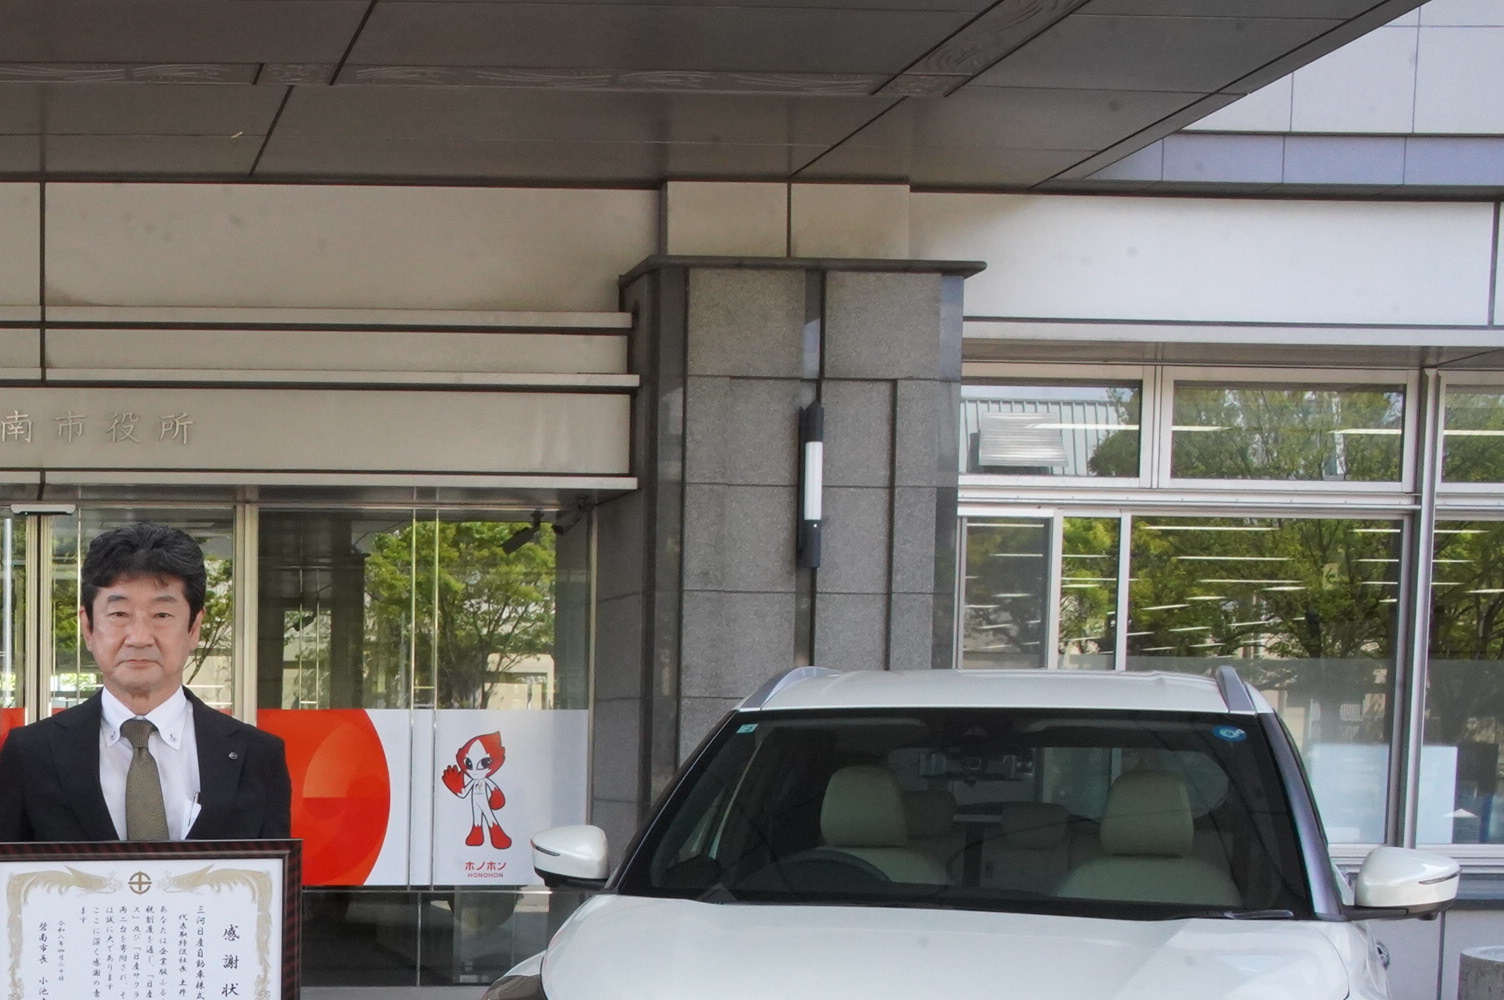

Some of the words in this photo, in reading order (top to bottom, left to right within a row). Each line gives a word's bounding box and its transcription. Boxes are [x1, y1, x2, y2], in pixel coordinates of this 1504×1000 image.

[465, 861, 507, 871] ホノホン
[79, 906, 88, 924] ます
[221, 924, 240, 998] 感謝状
